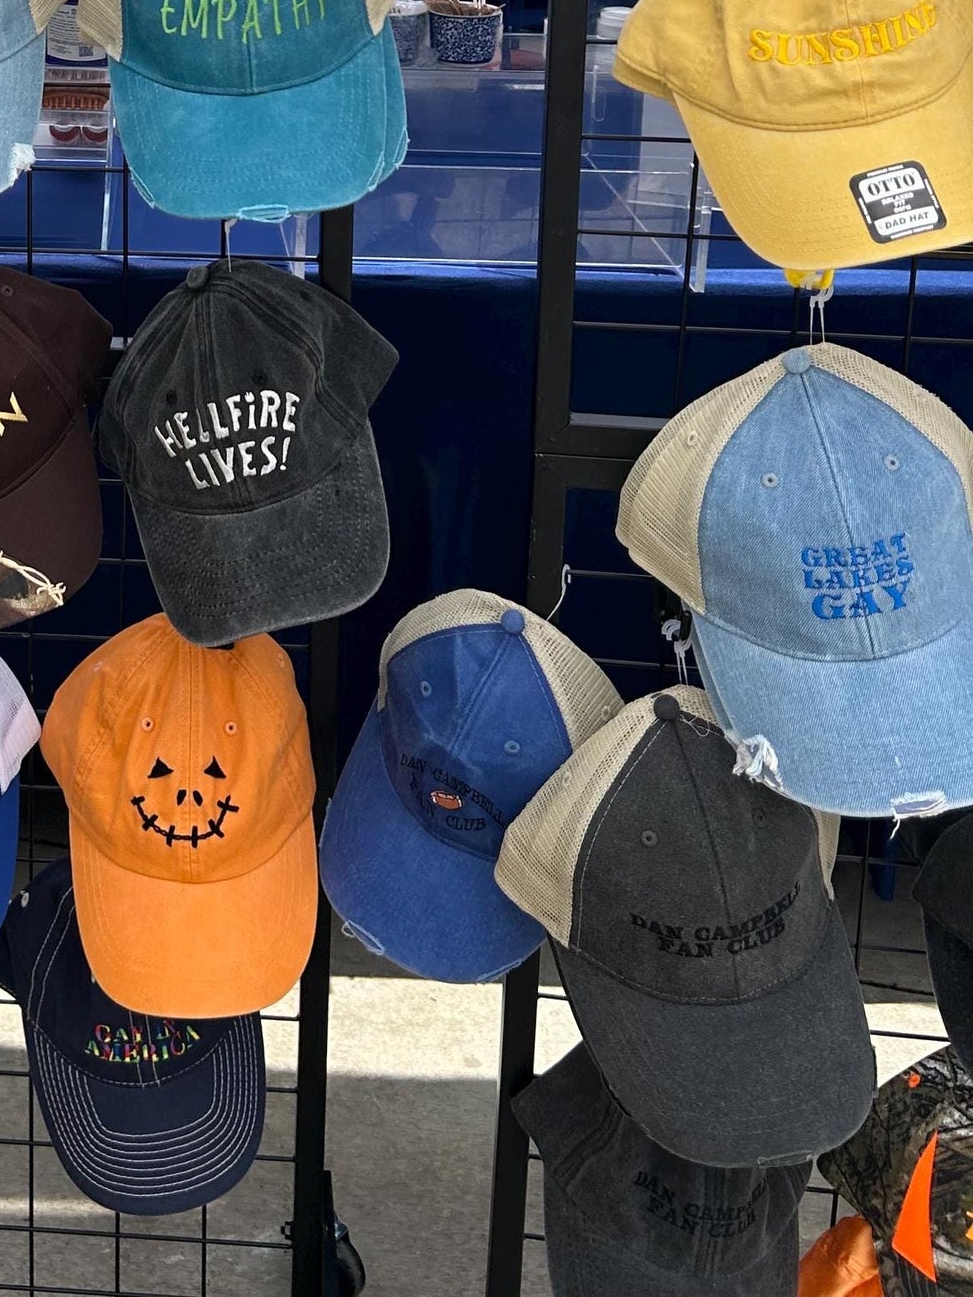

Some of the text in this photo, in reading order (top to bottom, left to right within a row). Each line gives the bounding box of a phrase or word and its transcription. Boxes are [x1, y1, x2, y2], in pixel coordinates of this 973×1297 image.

[867, 174, 915, 196] OTTO
[885, 212, 929, 229] DAD HAT
[185, 435, 291, 490] LIVES!
[801, 532, 906, 568] GREAT
[802, 555, 914, 589] LAKES
[812, 578, 910, 620] GAY
[446, 814, 486, 831] CLUB
[628, 912, 683, 939] DAN
[658, 916, 785, 958] FAN CLUB
[84, 1025, 201, 1062] AMERICA
[94, 1024, 143, 1043] GAY
[633, 1171, 676, 1205] DAN
[646, 1195, 700, 1235] FAN
